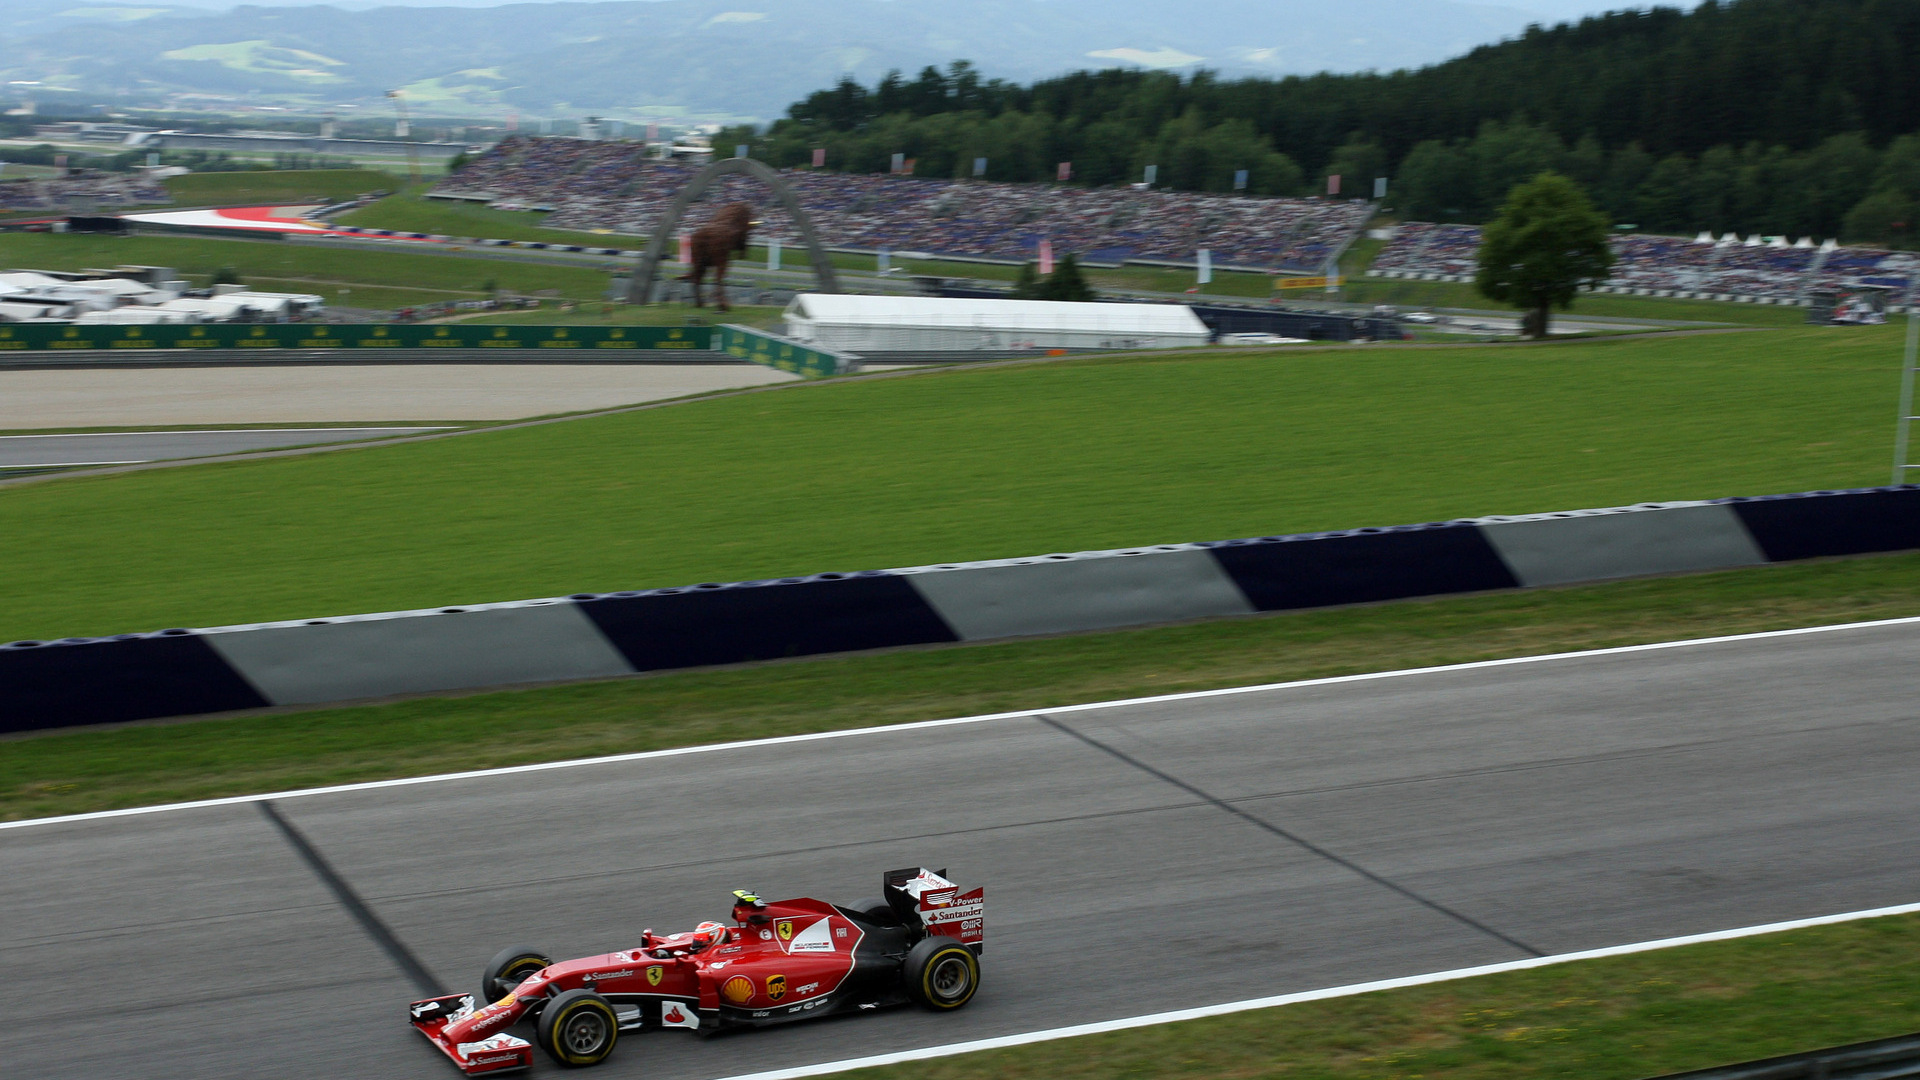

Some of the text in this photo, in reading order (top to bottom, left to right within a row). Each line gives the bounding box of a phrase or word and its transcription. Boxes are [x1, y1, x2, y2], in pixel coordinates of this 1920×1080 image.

[939, 906, 983, 921] Santander
[592, 969, 633, 980] Santander
[768, 982, 785, 998] ups
[477, 1052, 518, 1066] Santander
